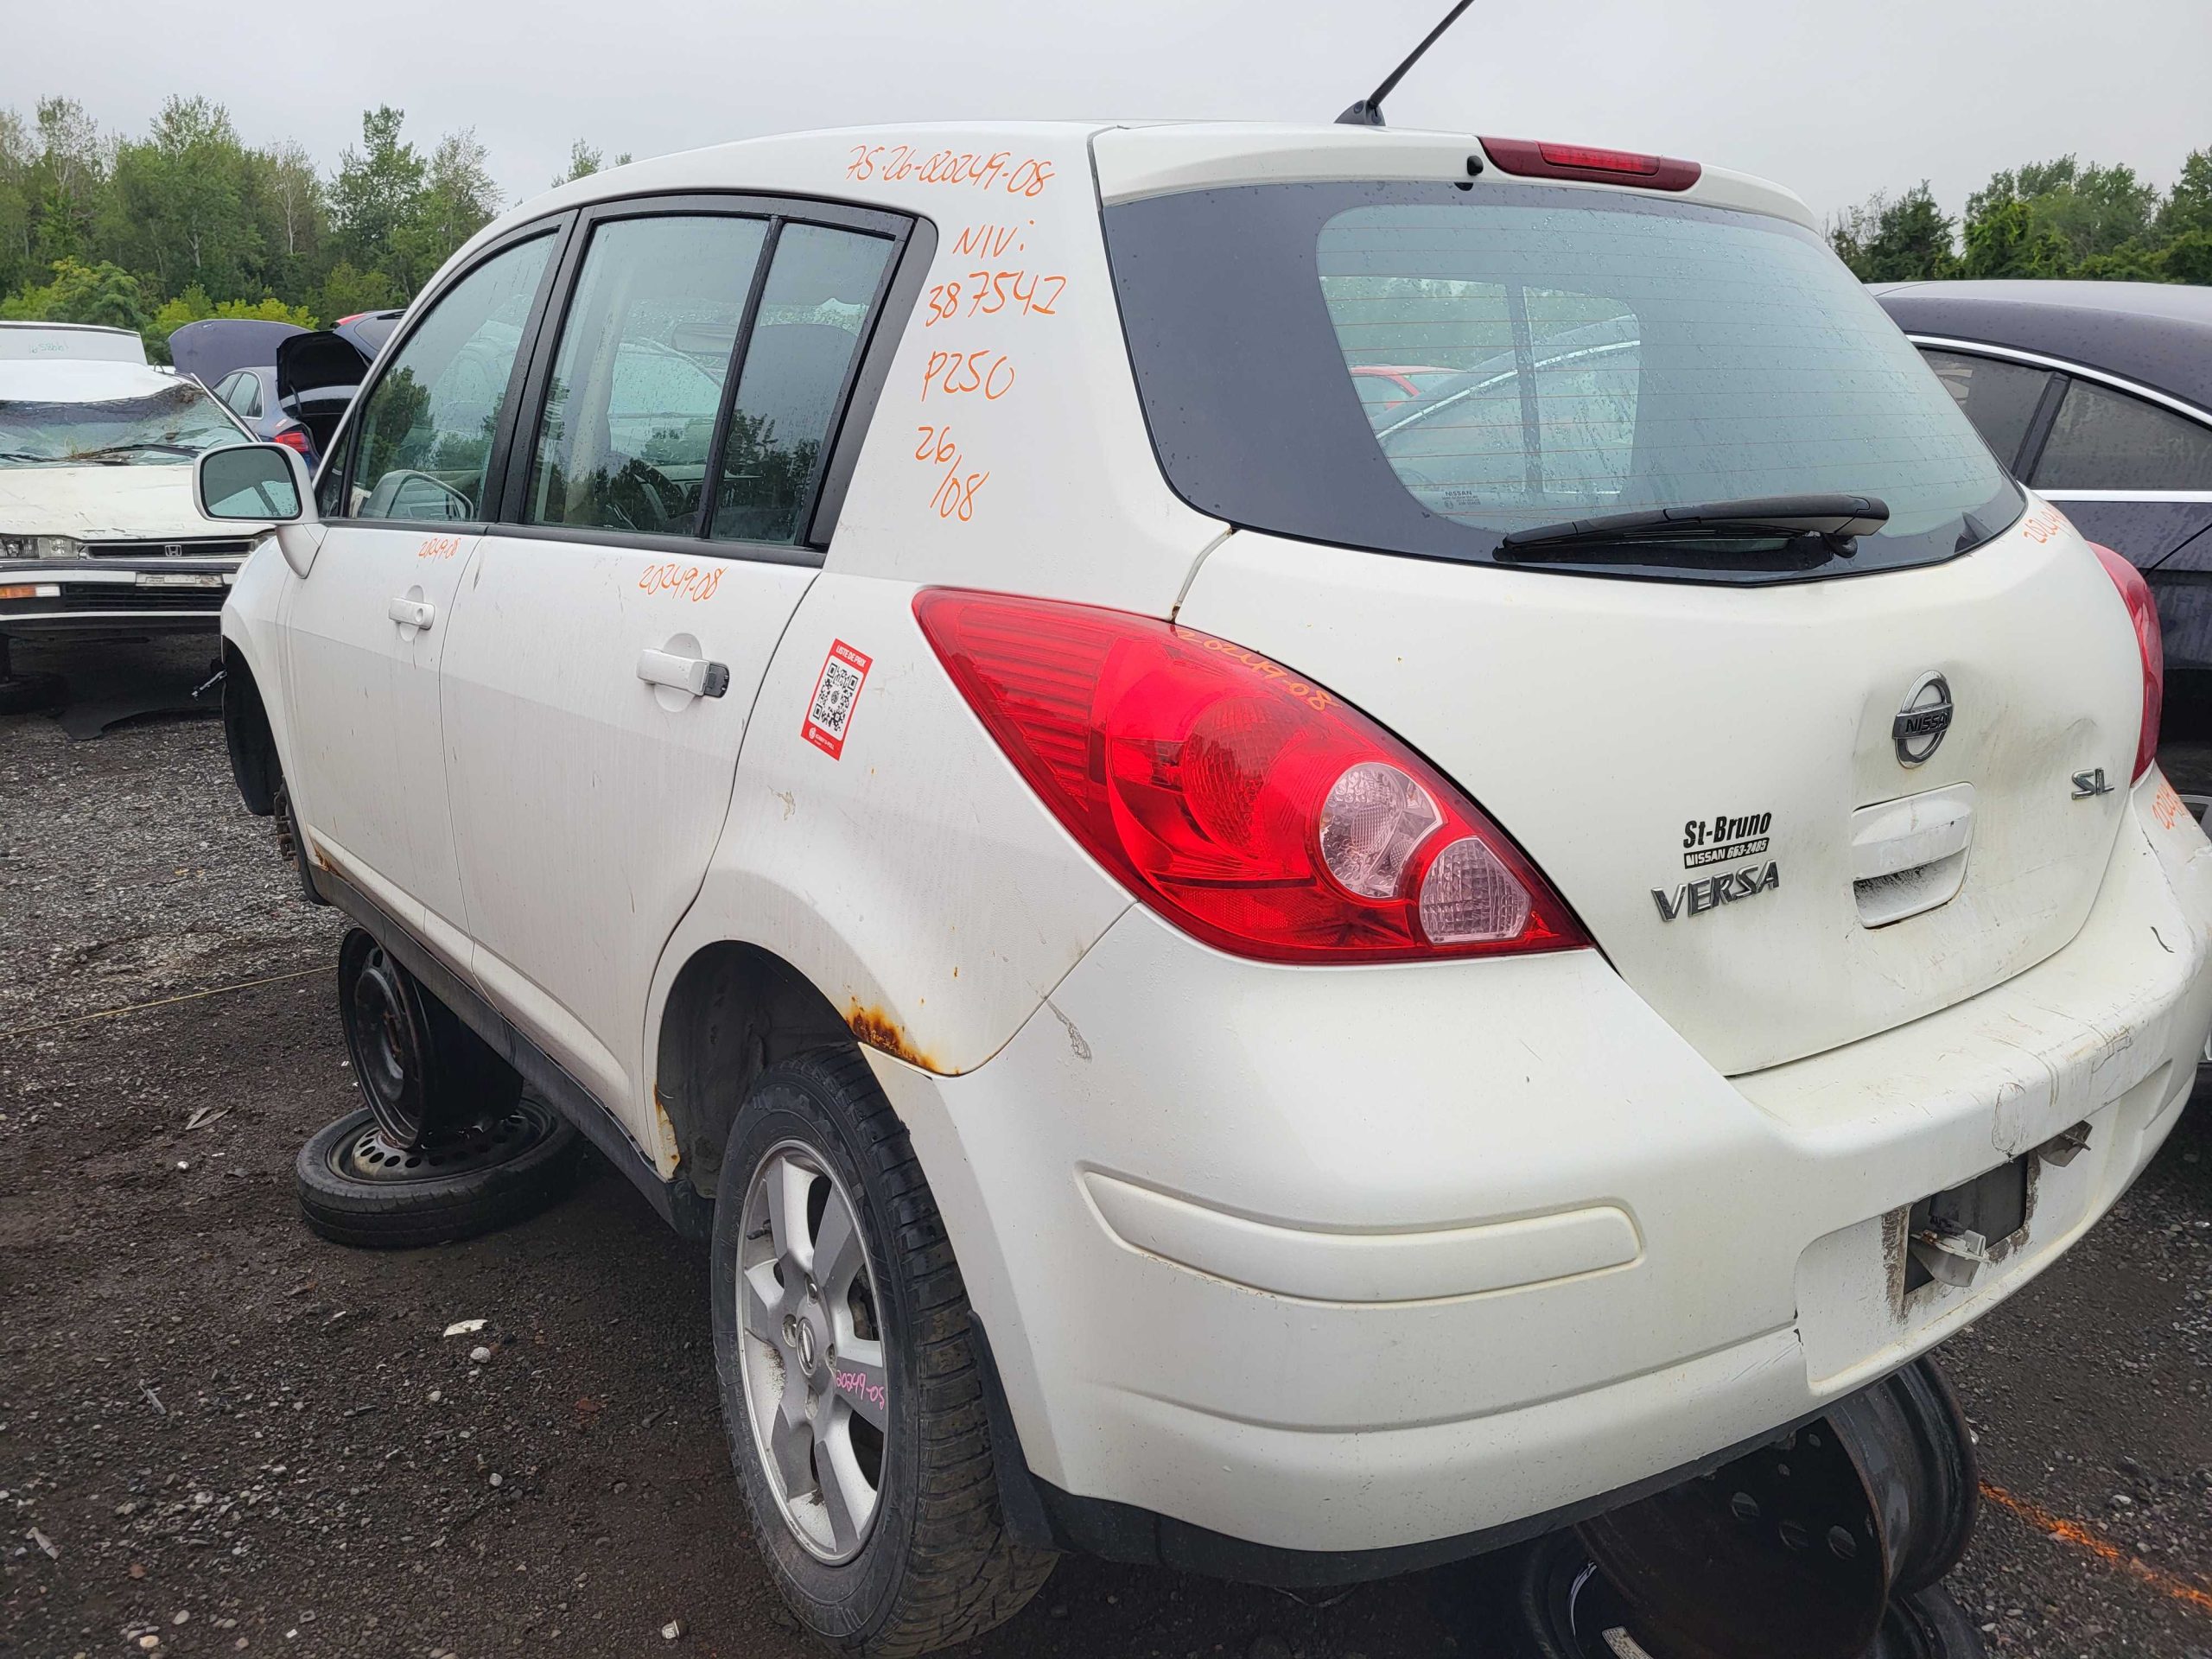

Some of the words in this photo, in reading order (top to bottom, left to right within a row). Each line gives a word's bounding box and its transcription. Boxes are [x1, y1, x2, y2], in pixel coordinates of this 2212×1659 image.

[921, 349, 1015, 403] P250
[2071, 767, 2115, 800] SL
[1682, 811, 1772, 849] St-Bruno
[1685, 848, 1726, 868] NISSAN
[1650, 858, 1780, 922] VERSA
